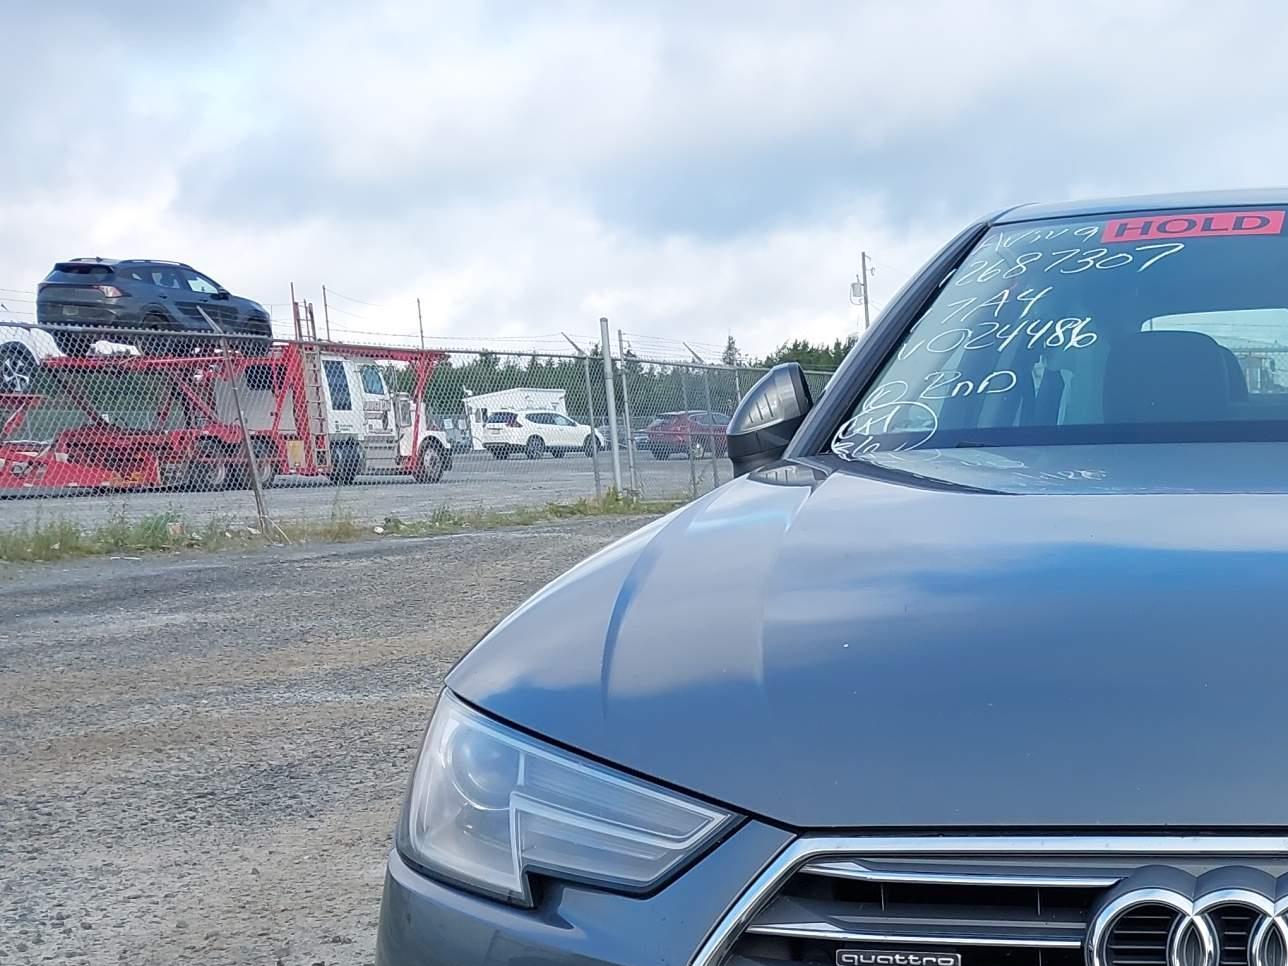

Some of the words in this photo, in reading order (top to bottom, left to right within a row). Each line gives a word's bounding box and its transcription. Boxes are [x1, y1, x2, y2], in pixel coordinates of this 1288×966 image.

[1113, 215, 1271, 238] HOLD
[938, 243, 1185, 288] 12687307
[841, 953, 955, 966] quattro
